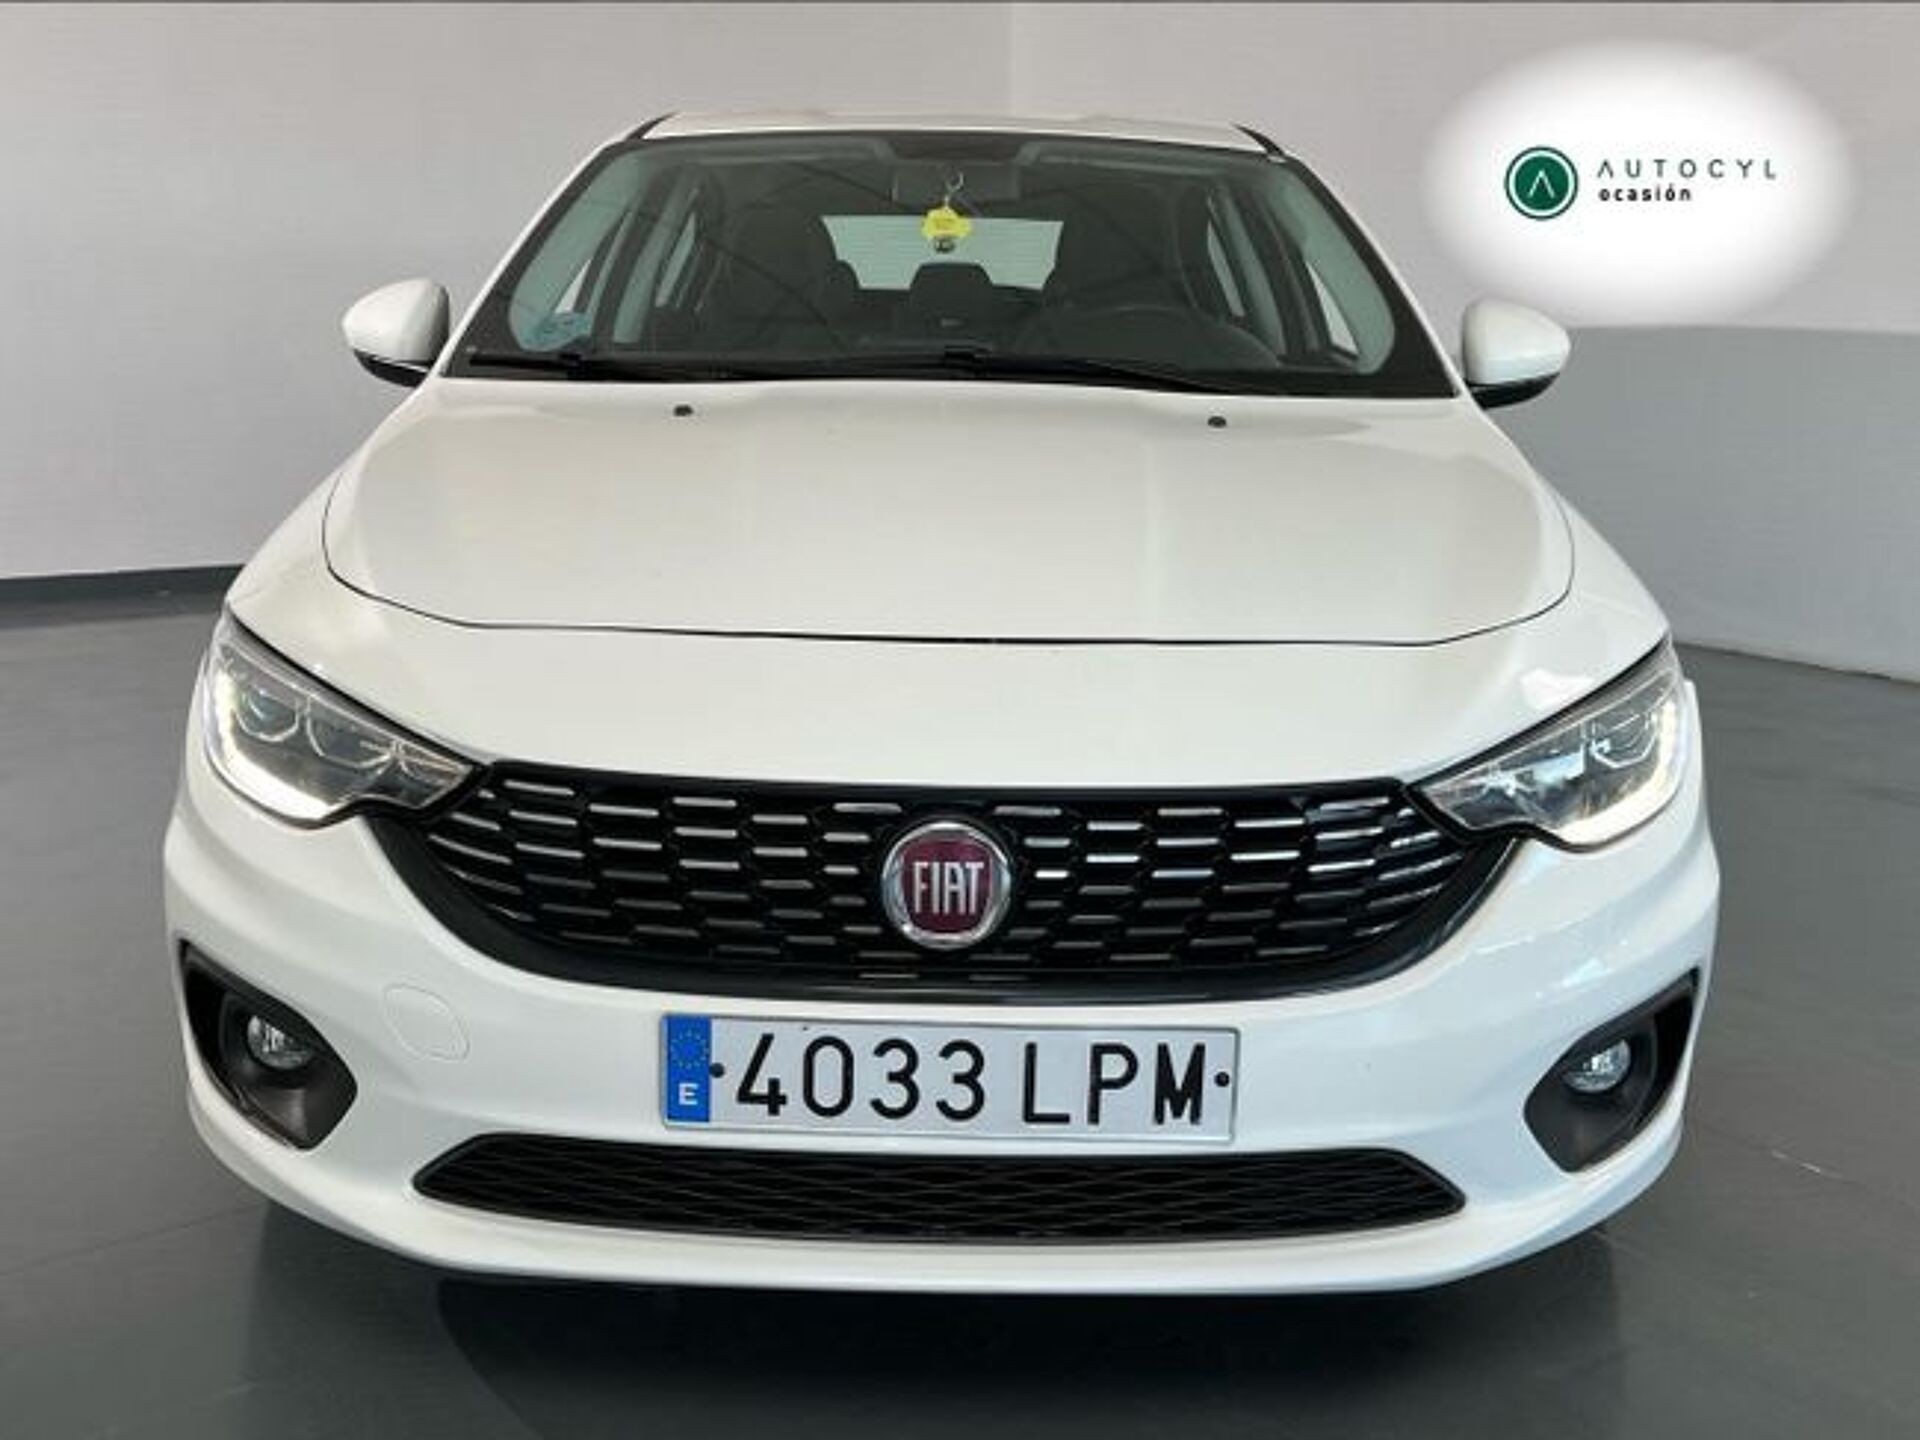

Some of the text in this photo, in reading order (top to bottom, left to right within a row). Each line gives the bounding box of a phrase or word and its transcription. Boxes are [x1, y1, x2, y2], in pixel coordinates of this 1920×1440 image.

[912, 861, 985, 915] FIAT
[677, 1083, 699, 1106] E
[736, 1033, 1207, 1126] 4033 LPM
